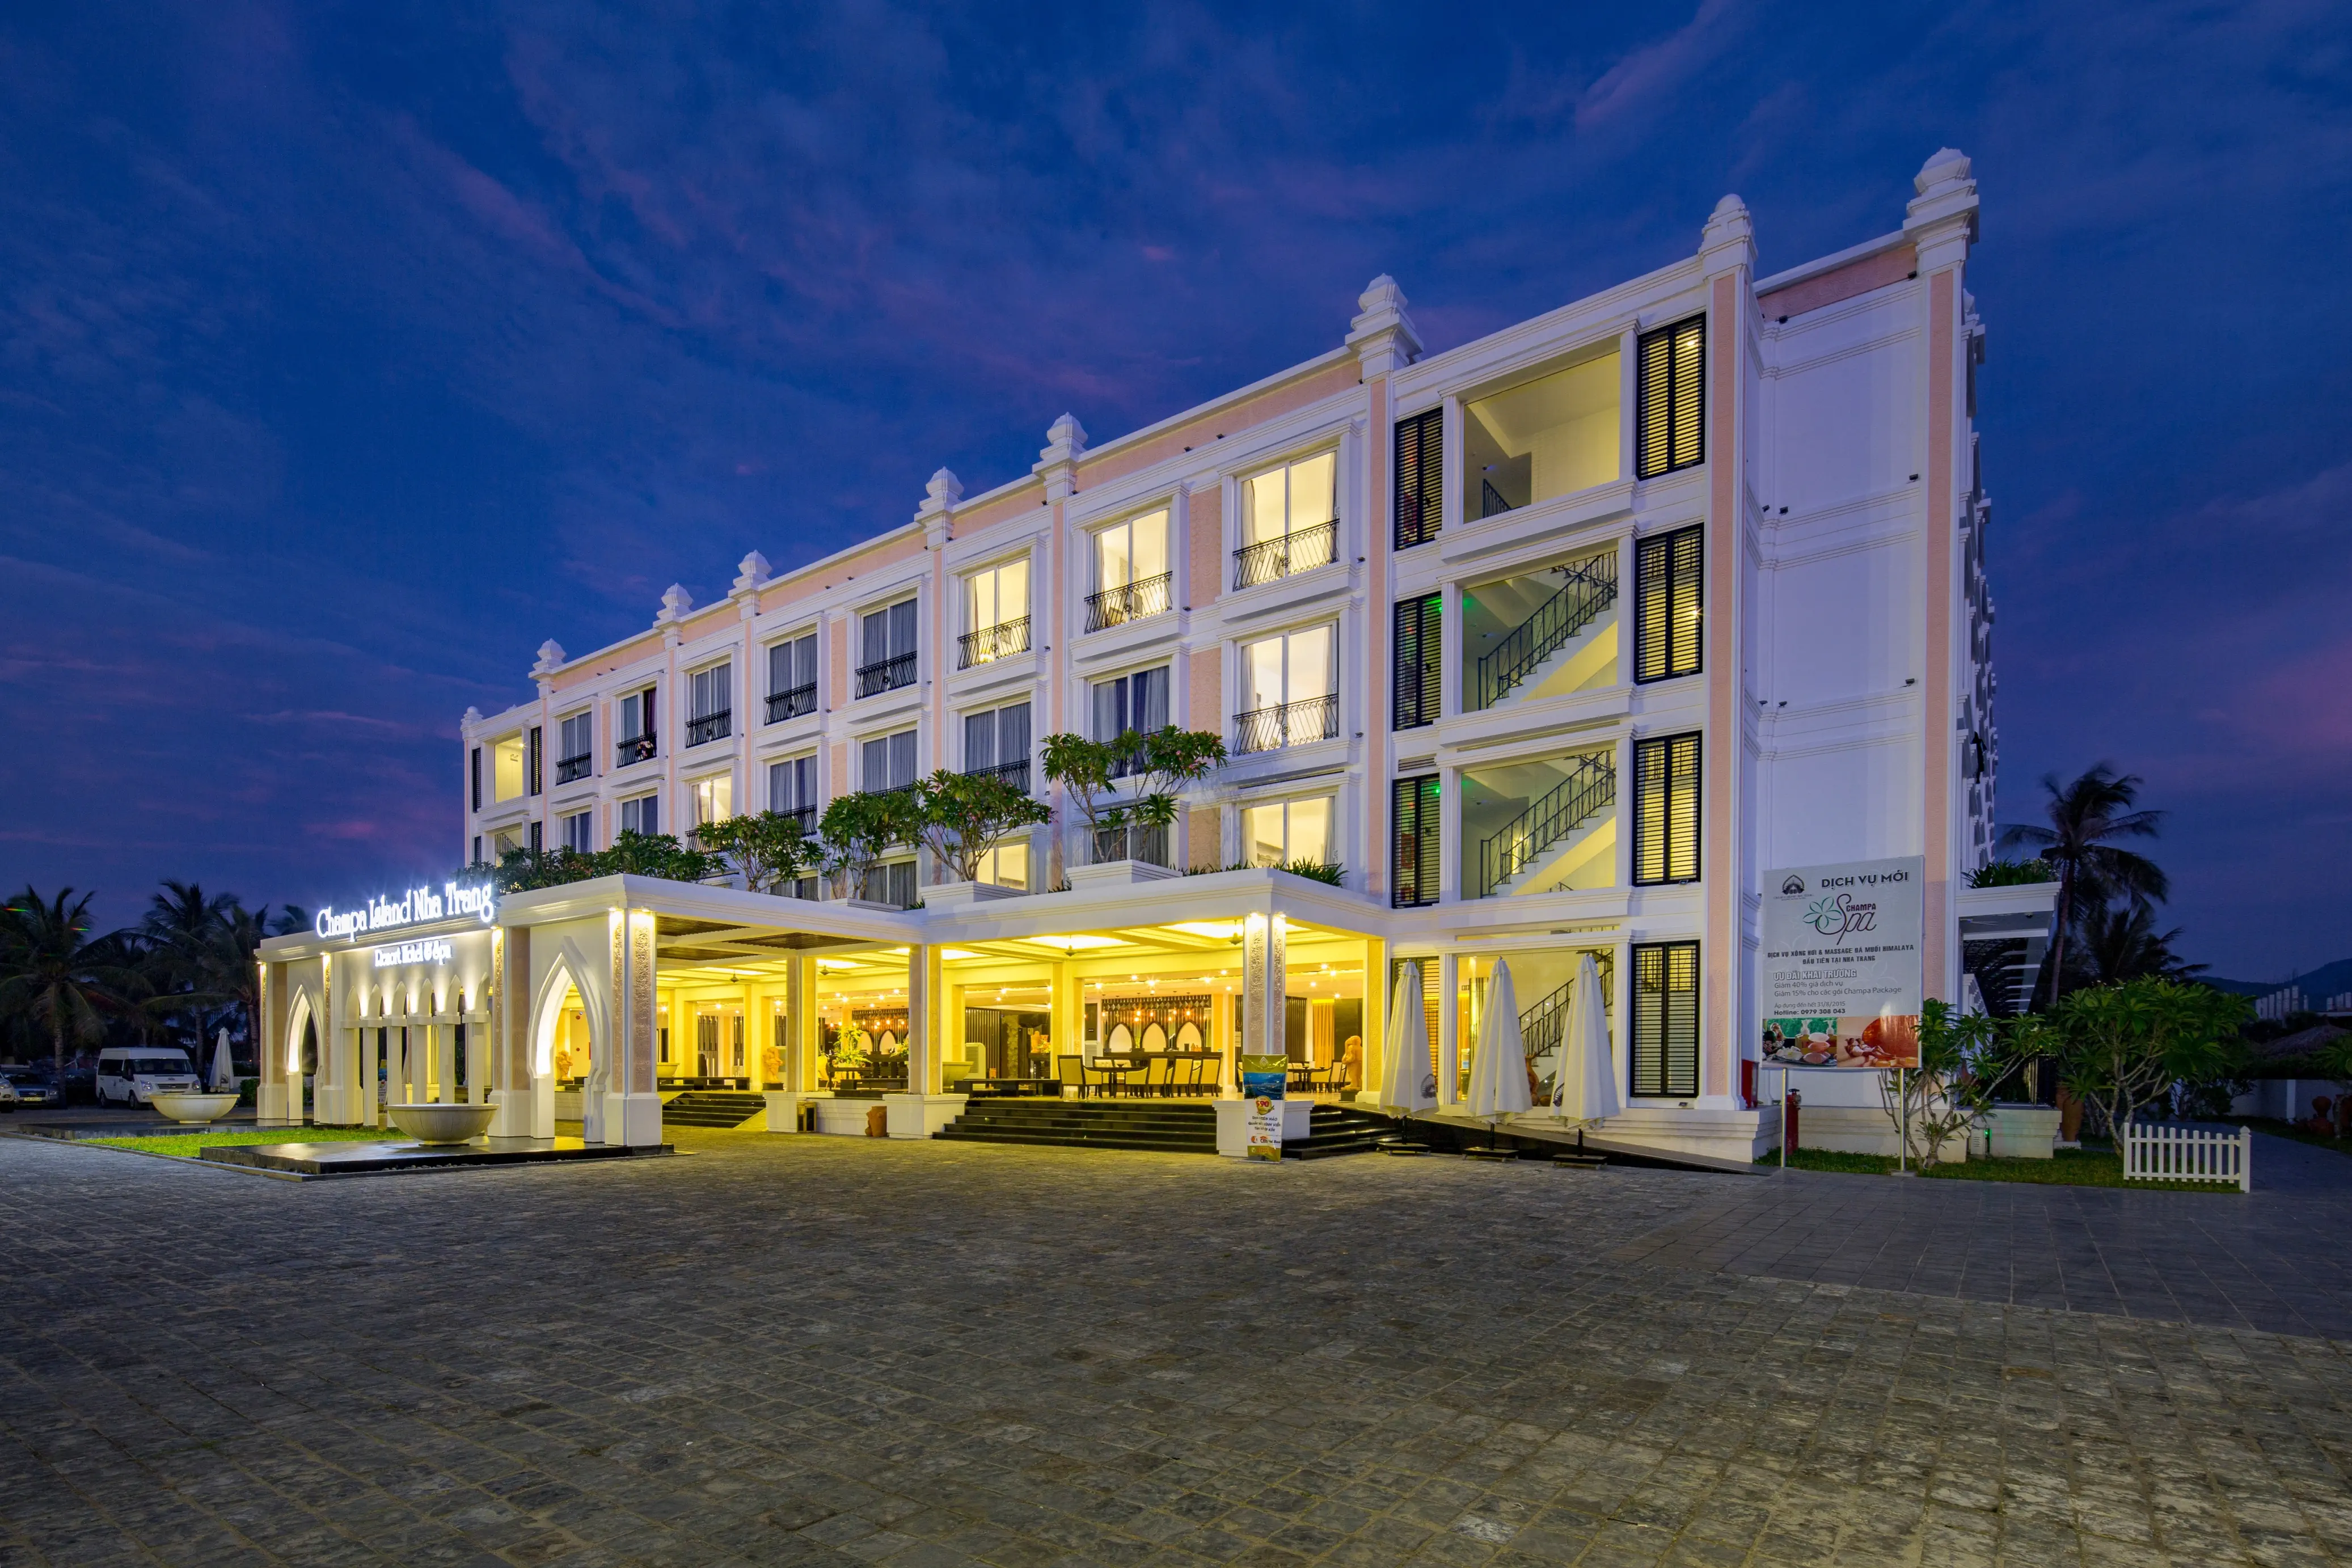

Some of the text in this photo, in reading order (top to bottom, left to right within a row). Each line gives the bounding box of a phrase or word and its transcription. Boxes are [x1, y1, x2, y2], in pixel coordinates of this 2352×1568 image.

[1822, 869, 1909, 890] DỊCH VỤ MỚI
[316, 882, 493, 942] Champa Island Nha Trang
[1846, 903, 1876, 912] CHAMPA
[1815, 894, 1877, 945] Spa
[1787, 970, 1801, 980] ĐÃI
[1802, 970, 1822, 980] KHAI
